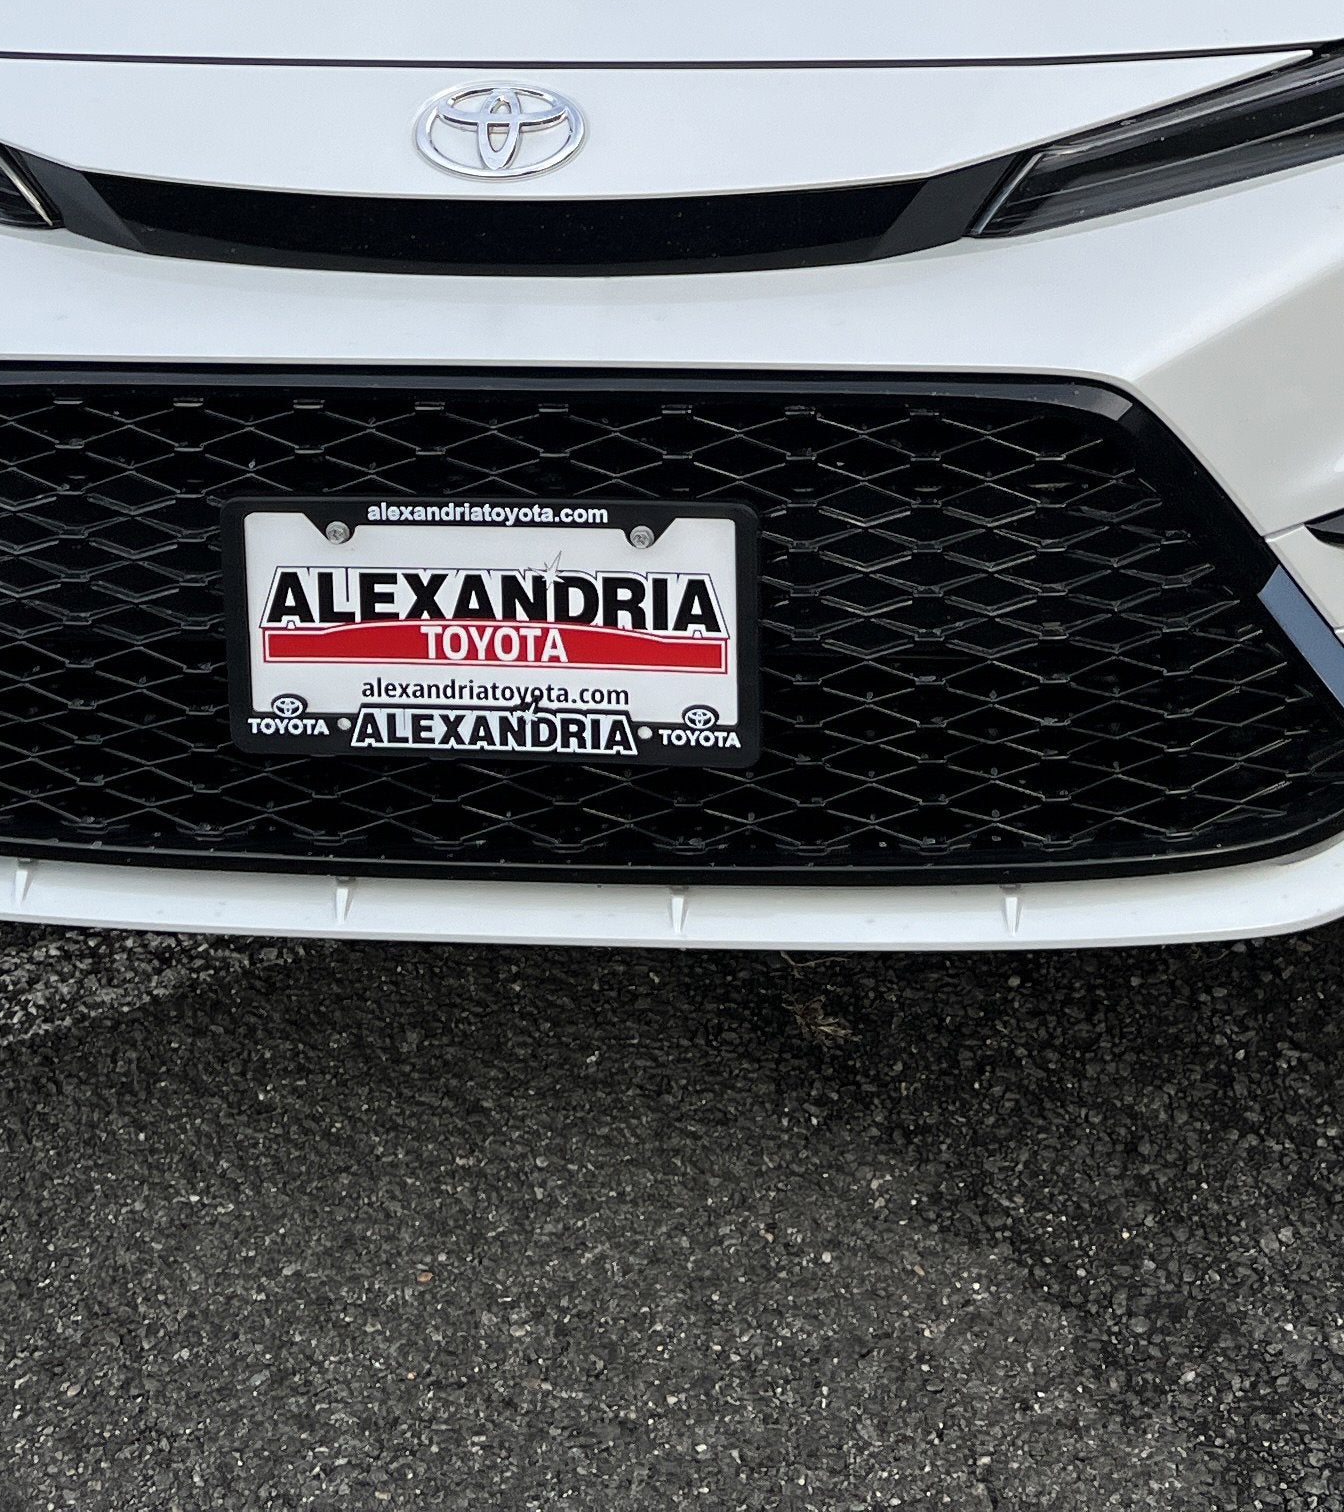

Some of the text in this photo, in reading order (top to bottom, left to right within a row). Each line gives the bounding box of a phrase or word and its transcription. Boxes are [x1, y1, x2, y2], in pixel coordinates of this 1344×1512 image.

[367, 502, 609, 526] alexandriatoyota.com
[264, 569, 724, 635] ALEXANDRIA
[420, 625, 569, 663] TOYOTA
[361, 677, 630, 706] alexandriatoyota.com
[247, 717, 330, 736] TOYOTA
[353, 709, 636, 755] ALEXANDRIA
[658, 729, 742, 749] TOYOTA
